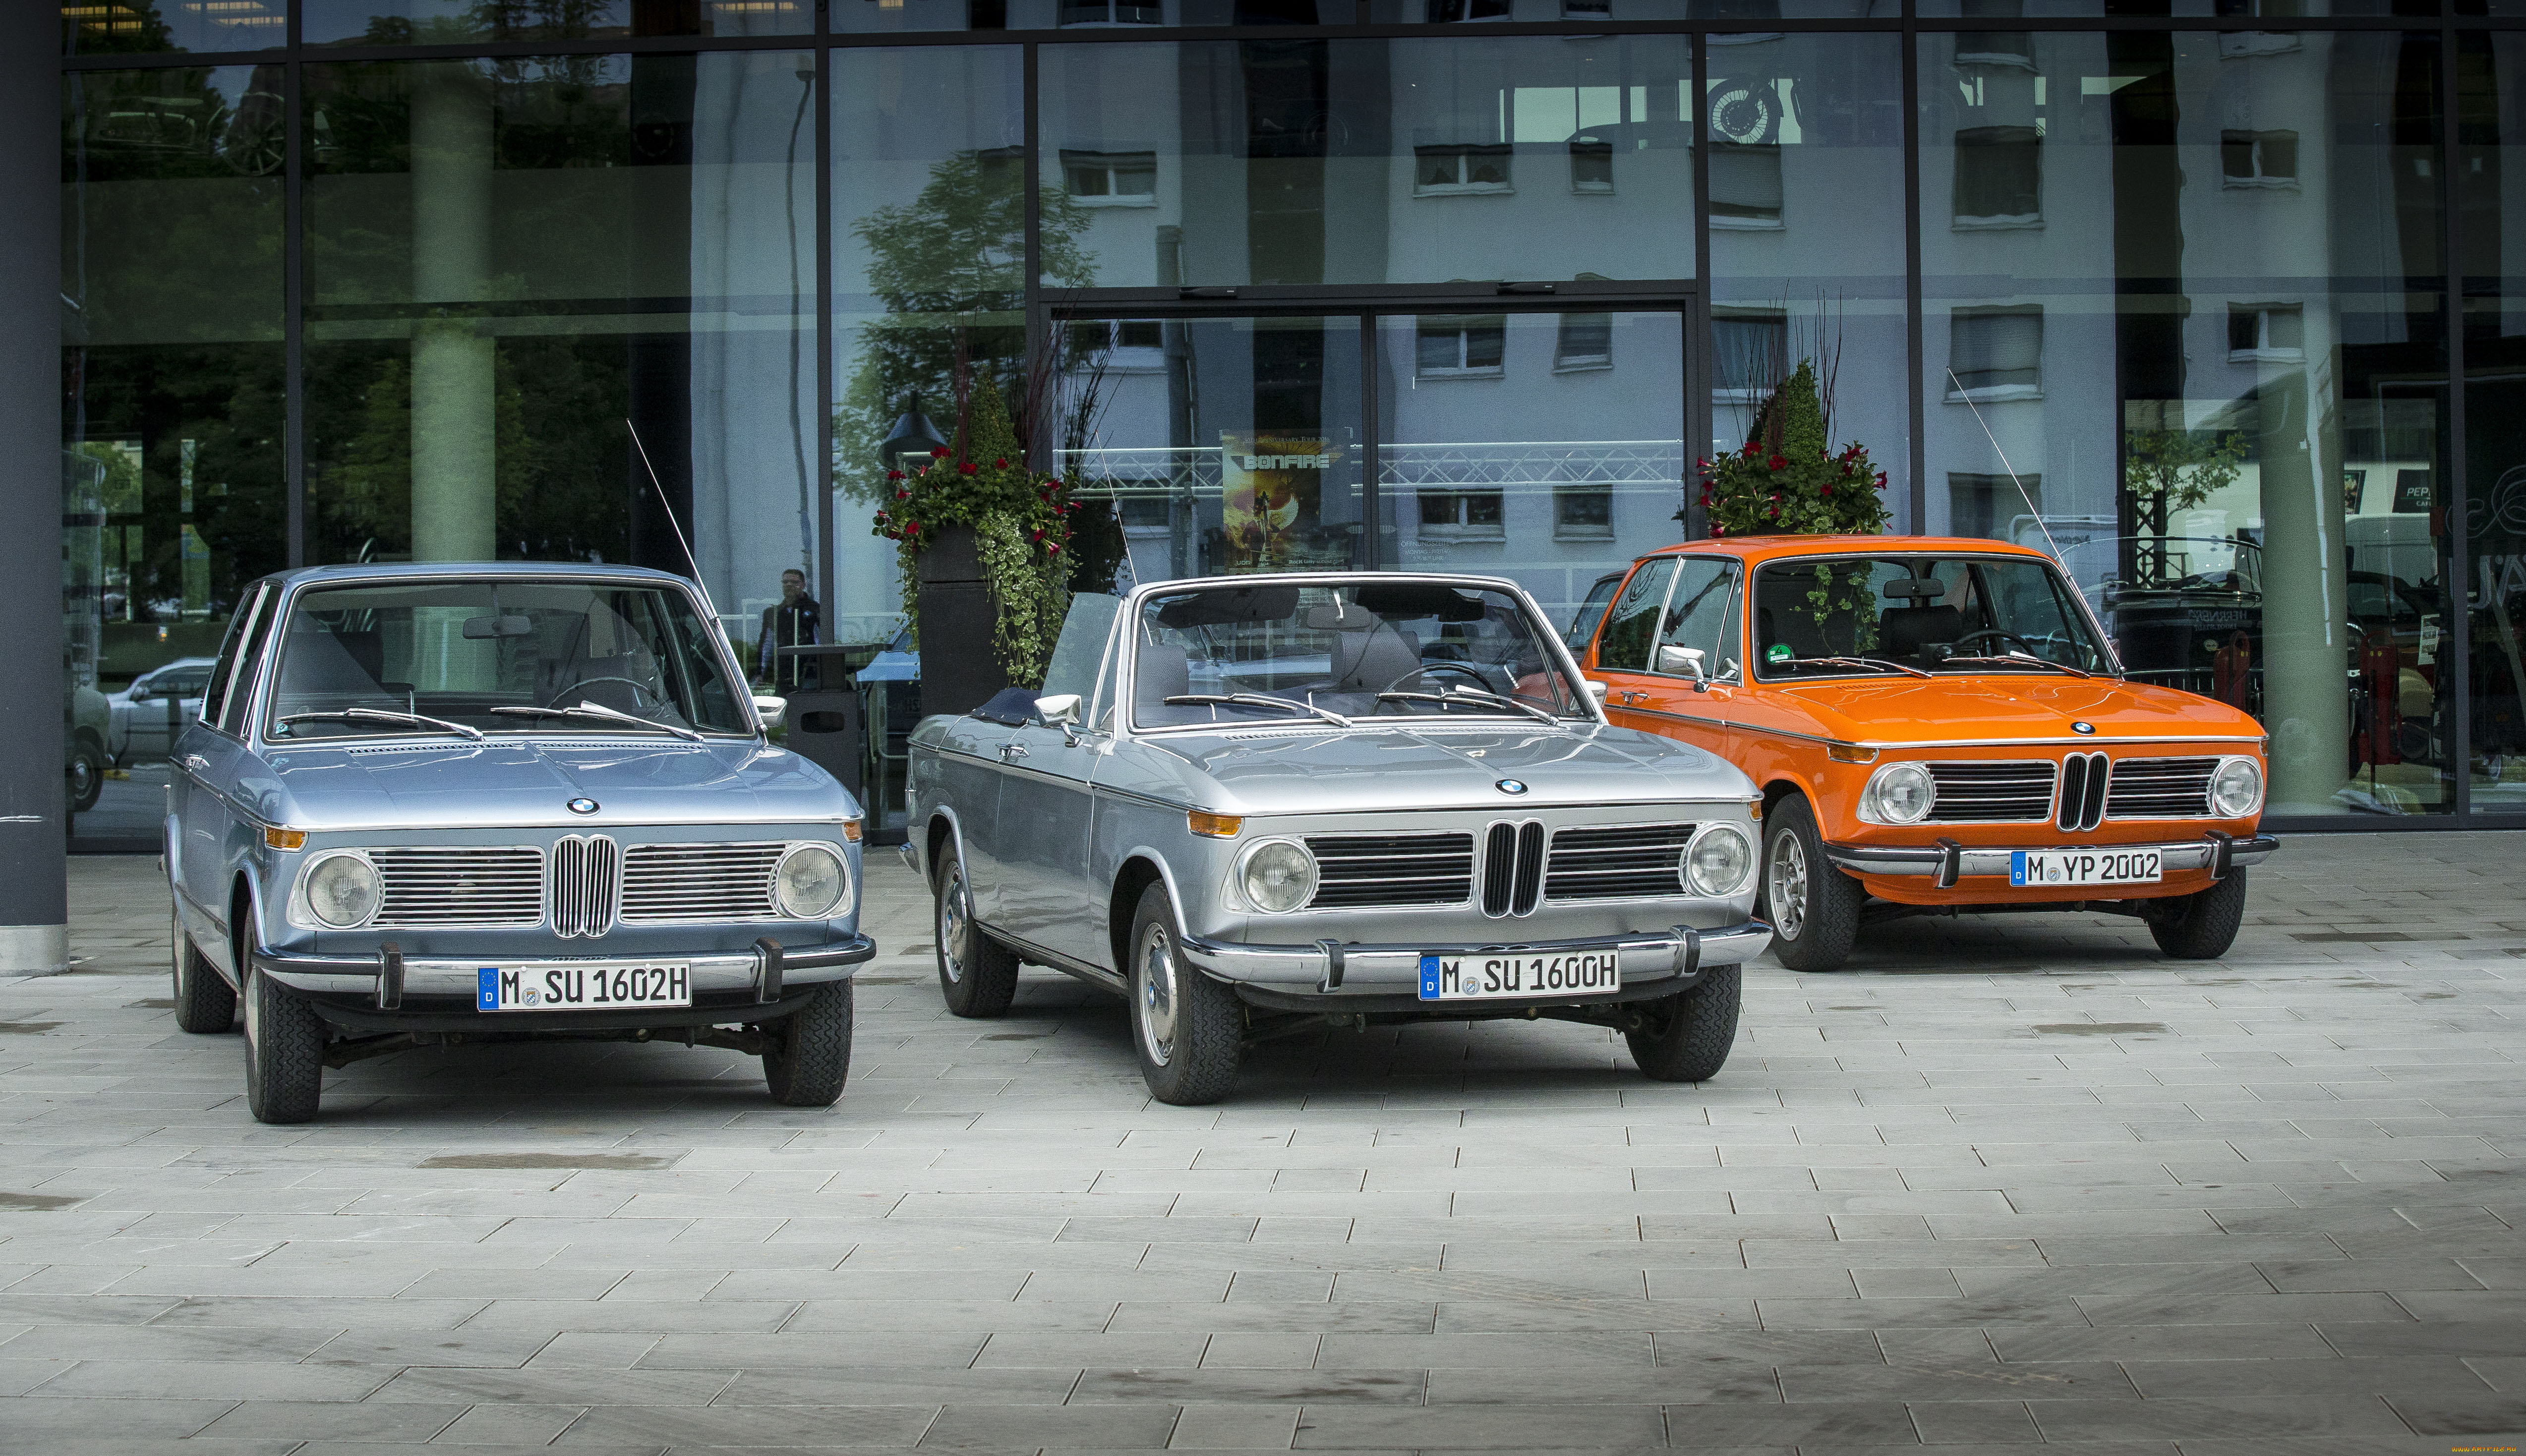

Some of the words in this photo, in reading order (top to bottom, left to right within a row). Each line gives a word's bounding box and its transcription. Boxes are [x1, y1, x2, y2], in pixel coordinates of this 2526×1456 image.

[1243, 454, 1330, 470] BONFIRE
[2407, 486, 2430, 497] PEP
[1775, 646, 1783, 654] 4
[2028, 856, 2044, 881] M
[2063, 856, 2095, 881] YP
[2101, 853, 2159, 880] 2002
[1426, 981, 1434, 991] D
[1442, 961, 1459, 993] M
[1484, 960, 1521, 992] SU
[1530, 954, 1616, 990] 1600H
[485, 992, 493, 1002] D
[501, 970, 520, 1004] M
[545, 970, 584, 1003] SU
[593, 967, 687, 1002] 1602H
